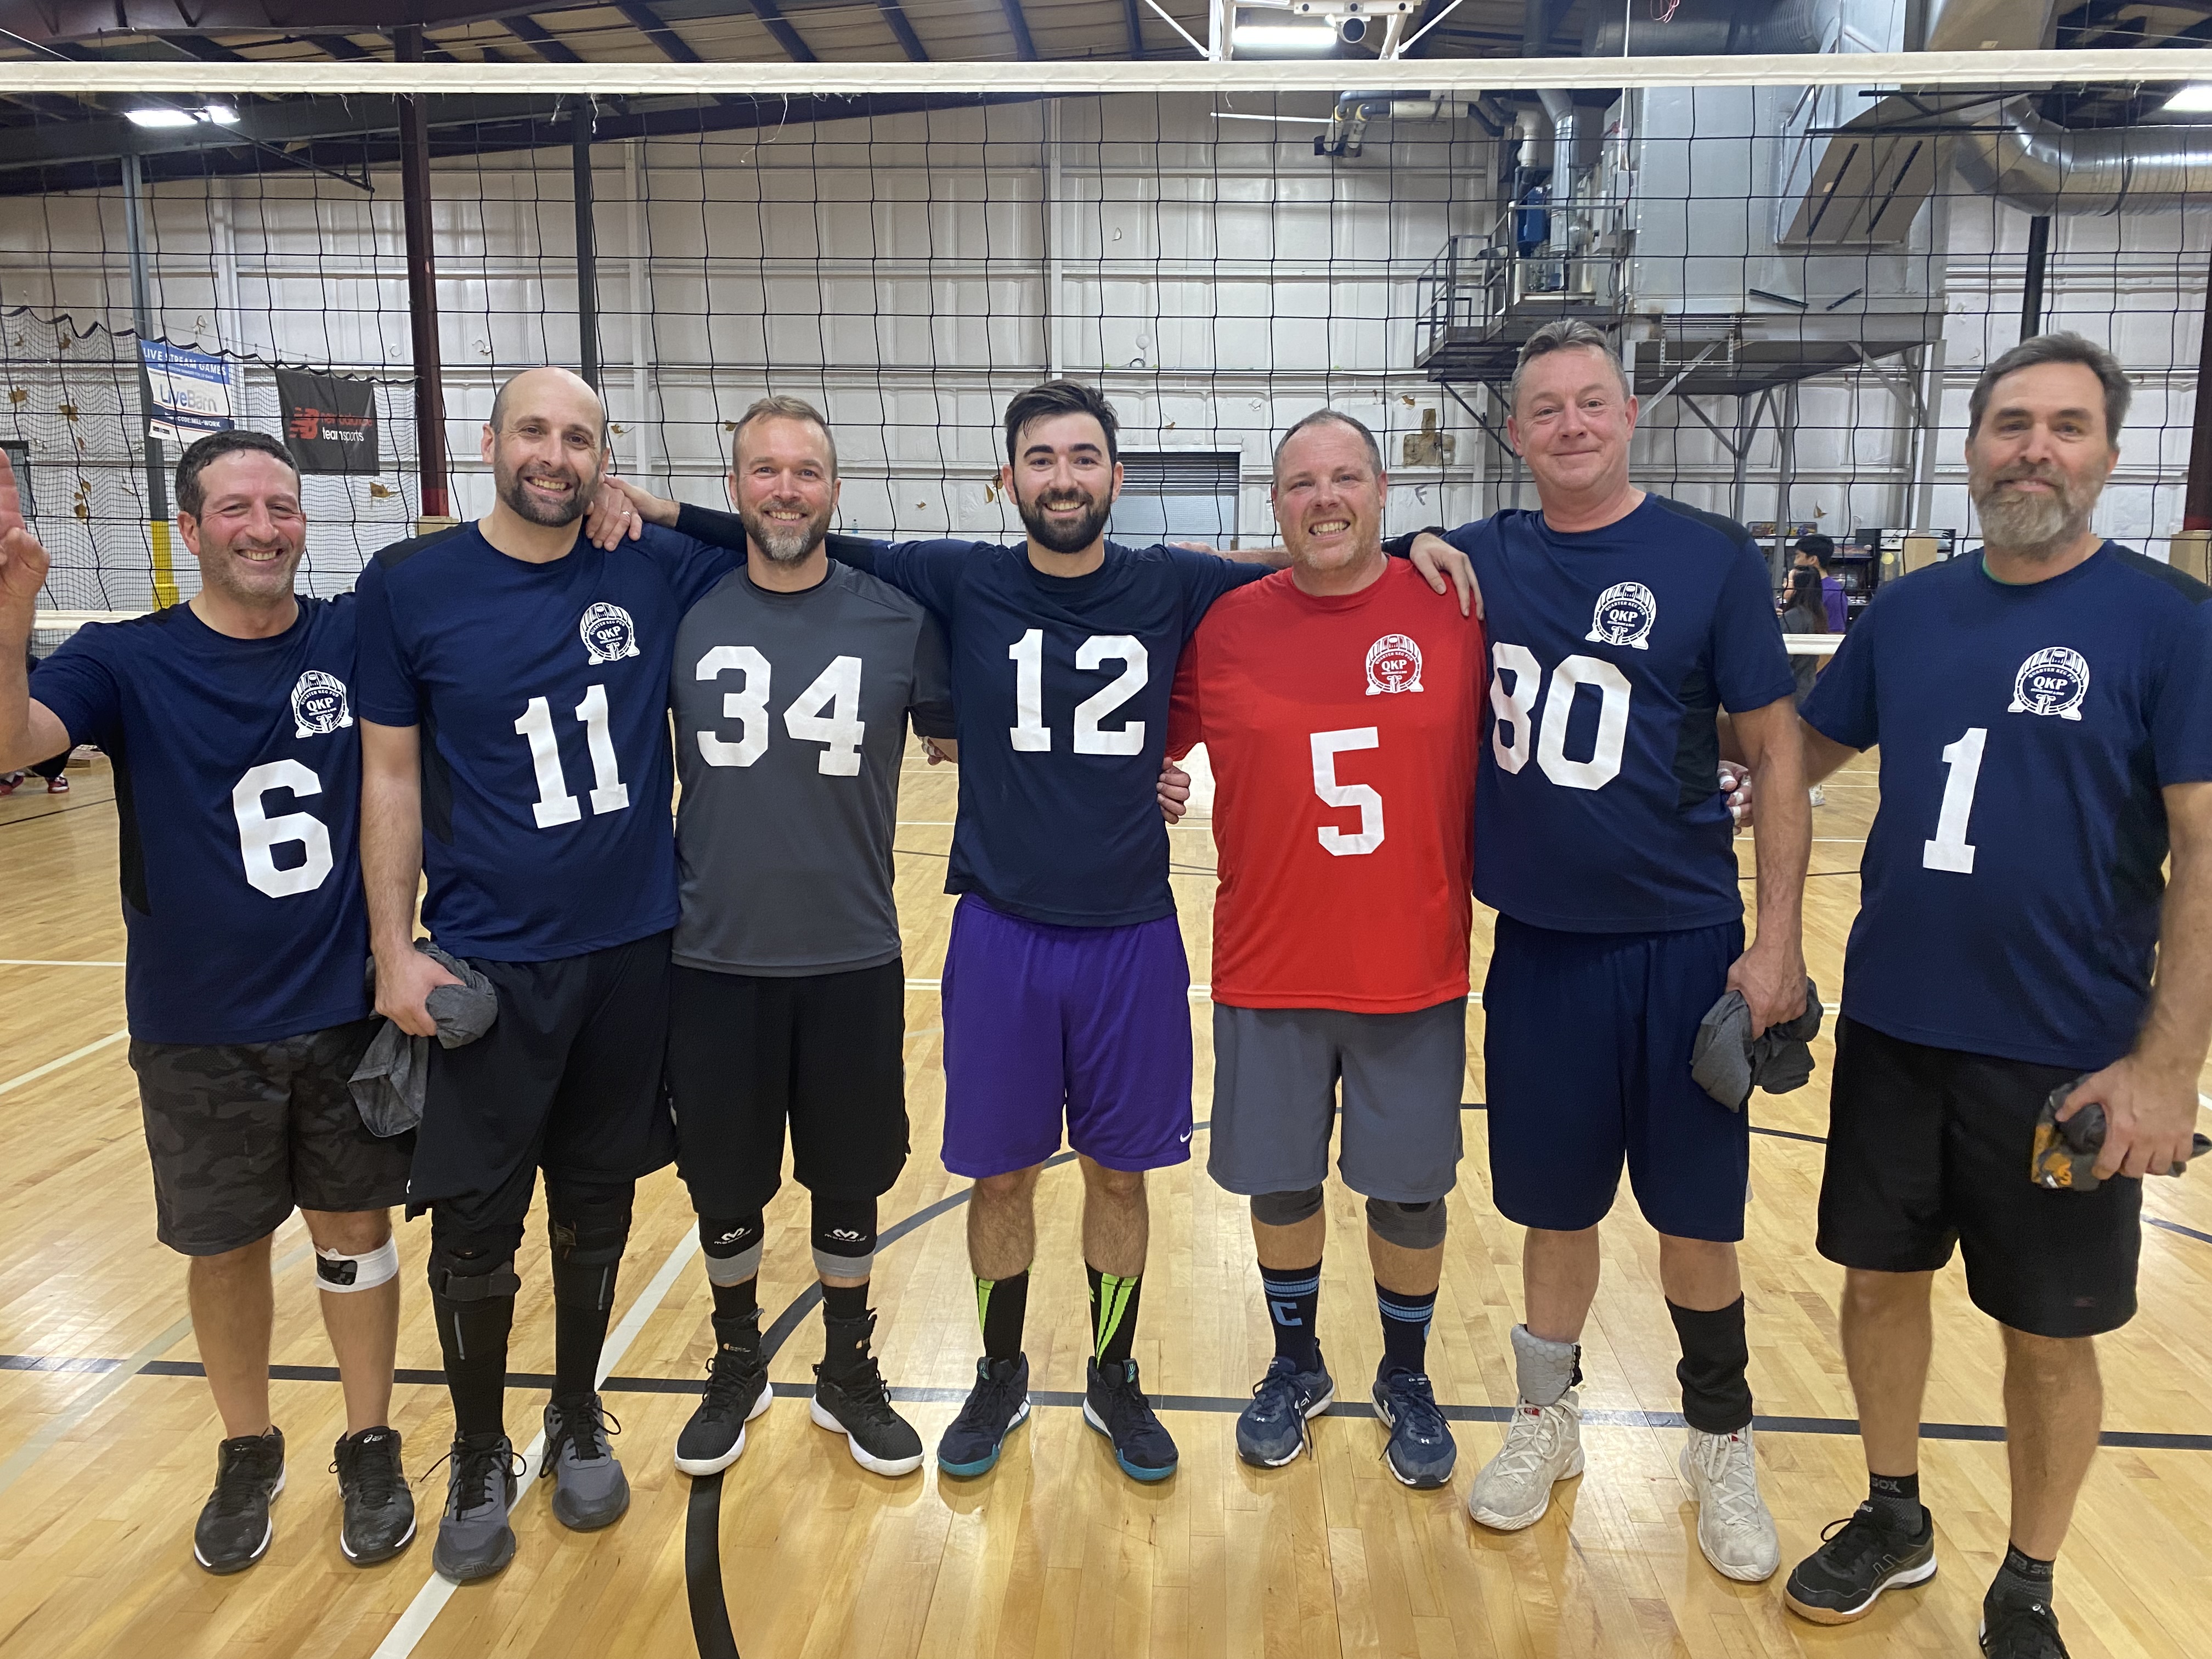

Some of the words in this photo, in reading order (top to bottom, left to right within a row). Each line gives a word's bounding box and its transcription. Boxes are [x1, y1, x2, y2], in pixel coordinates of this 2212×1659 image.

[143, 347, 163, 361] LIVE
[199, 361, 226, 376] GAMES
[160, 384, 217, 412] LiveBarn
[1609, 609, 1638, 622] QKP
[596, 625, 621, 640] QKP
[1381, 659, 1407, 672] QKP
[1009, 629, 1148, 755] 12
[2033, 676, 2068, 690] QKP
[306, 697, 334, 712] QKP
[696, 646, 865, 776] 34
[1490, 642, 1632, 791] 80
[515, 684, 629, 828] 11
[1310, 727, 1384, 856] 5
[1923, 728, 1987, 873] 1
[233, 759, 333, 898] 6
[1271, 1301, 1302, 1326] C
